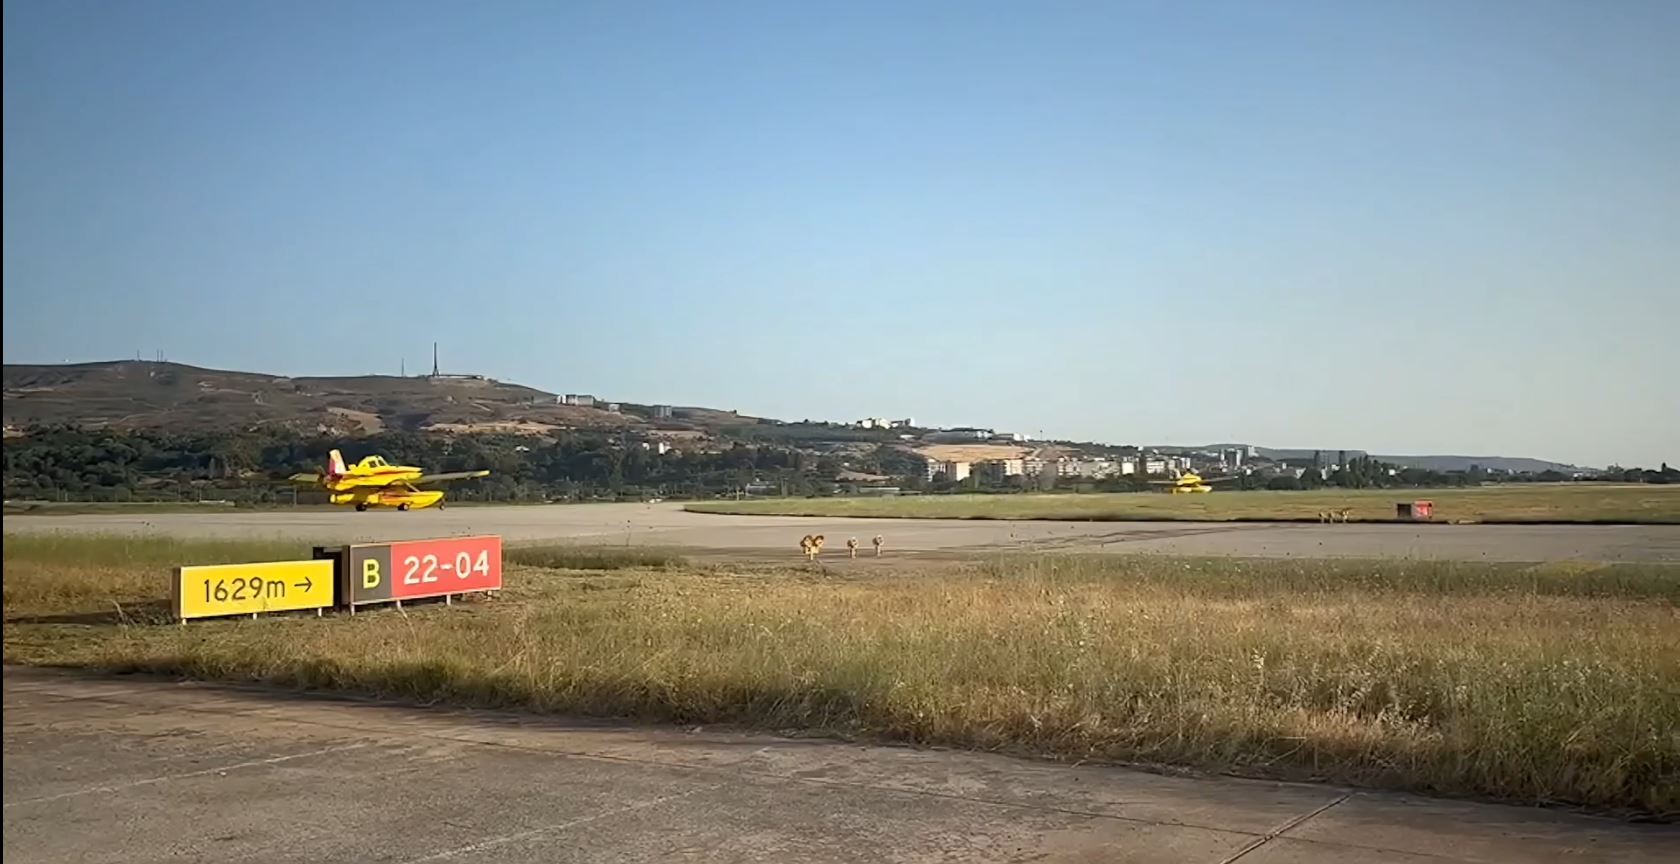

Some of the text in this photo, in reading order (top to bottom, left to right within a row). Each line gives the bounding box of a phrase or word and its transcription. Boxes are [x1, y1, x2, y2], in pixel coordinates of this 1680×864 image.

[363, 550, 489, 589] B 22-04
[204, 576, 285, 603] 1629m
